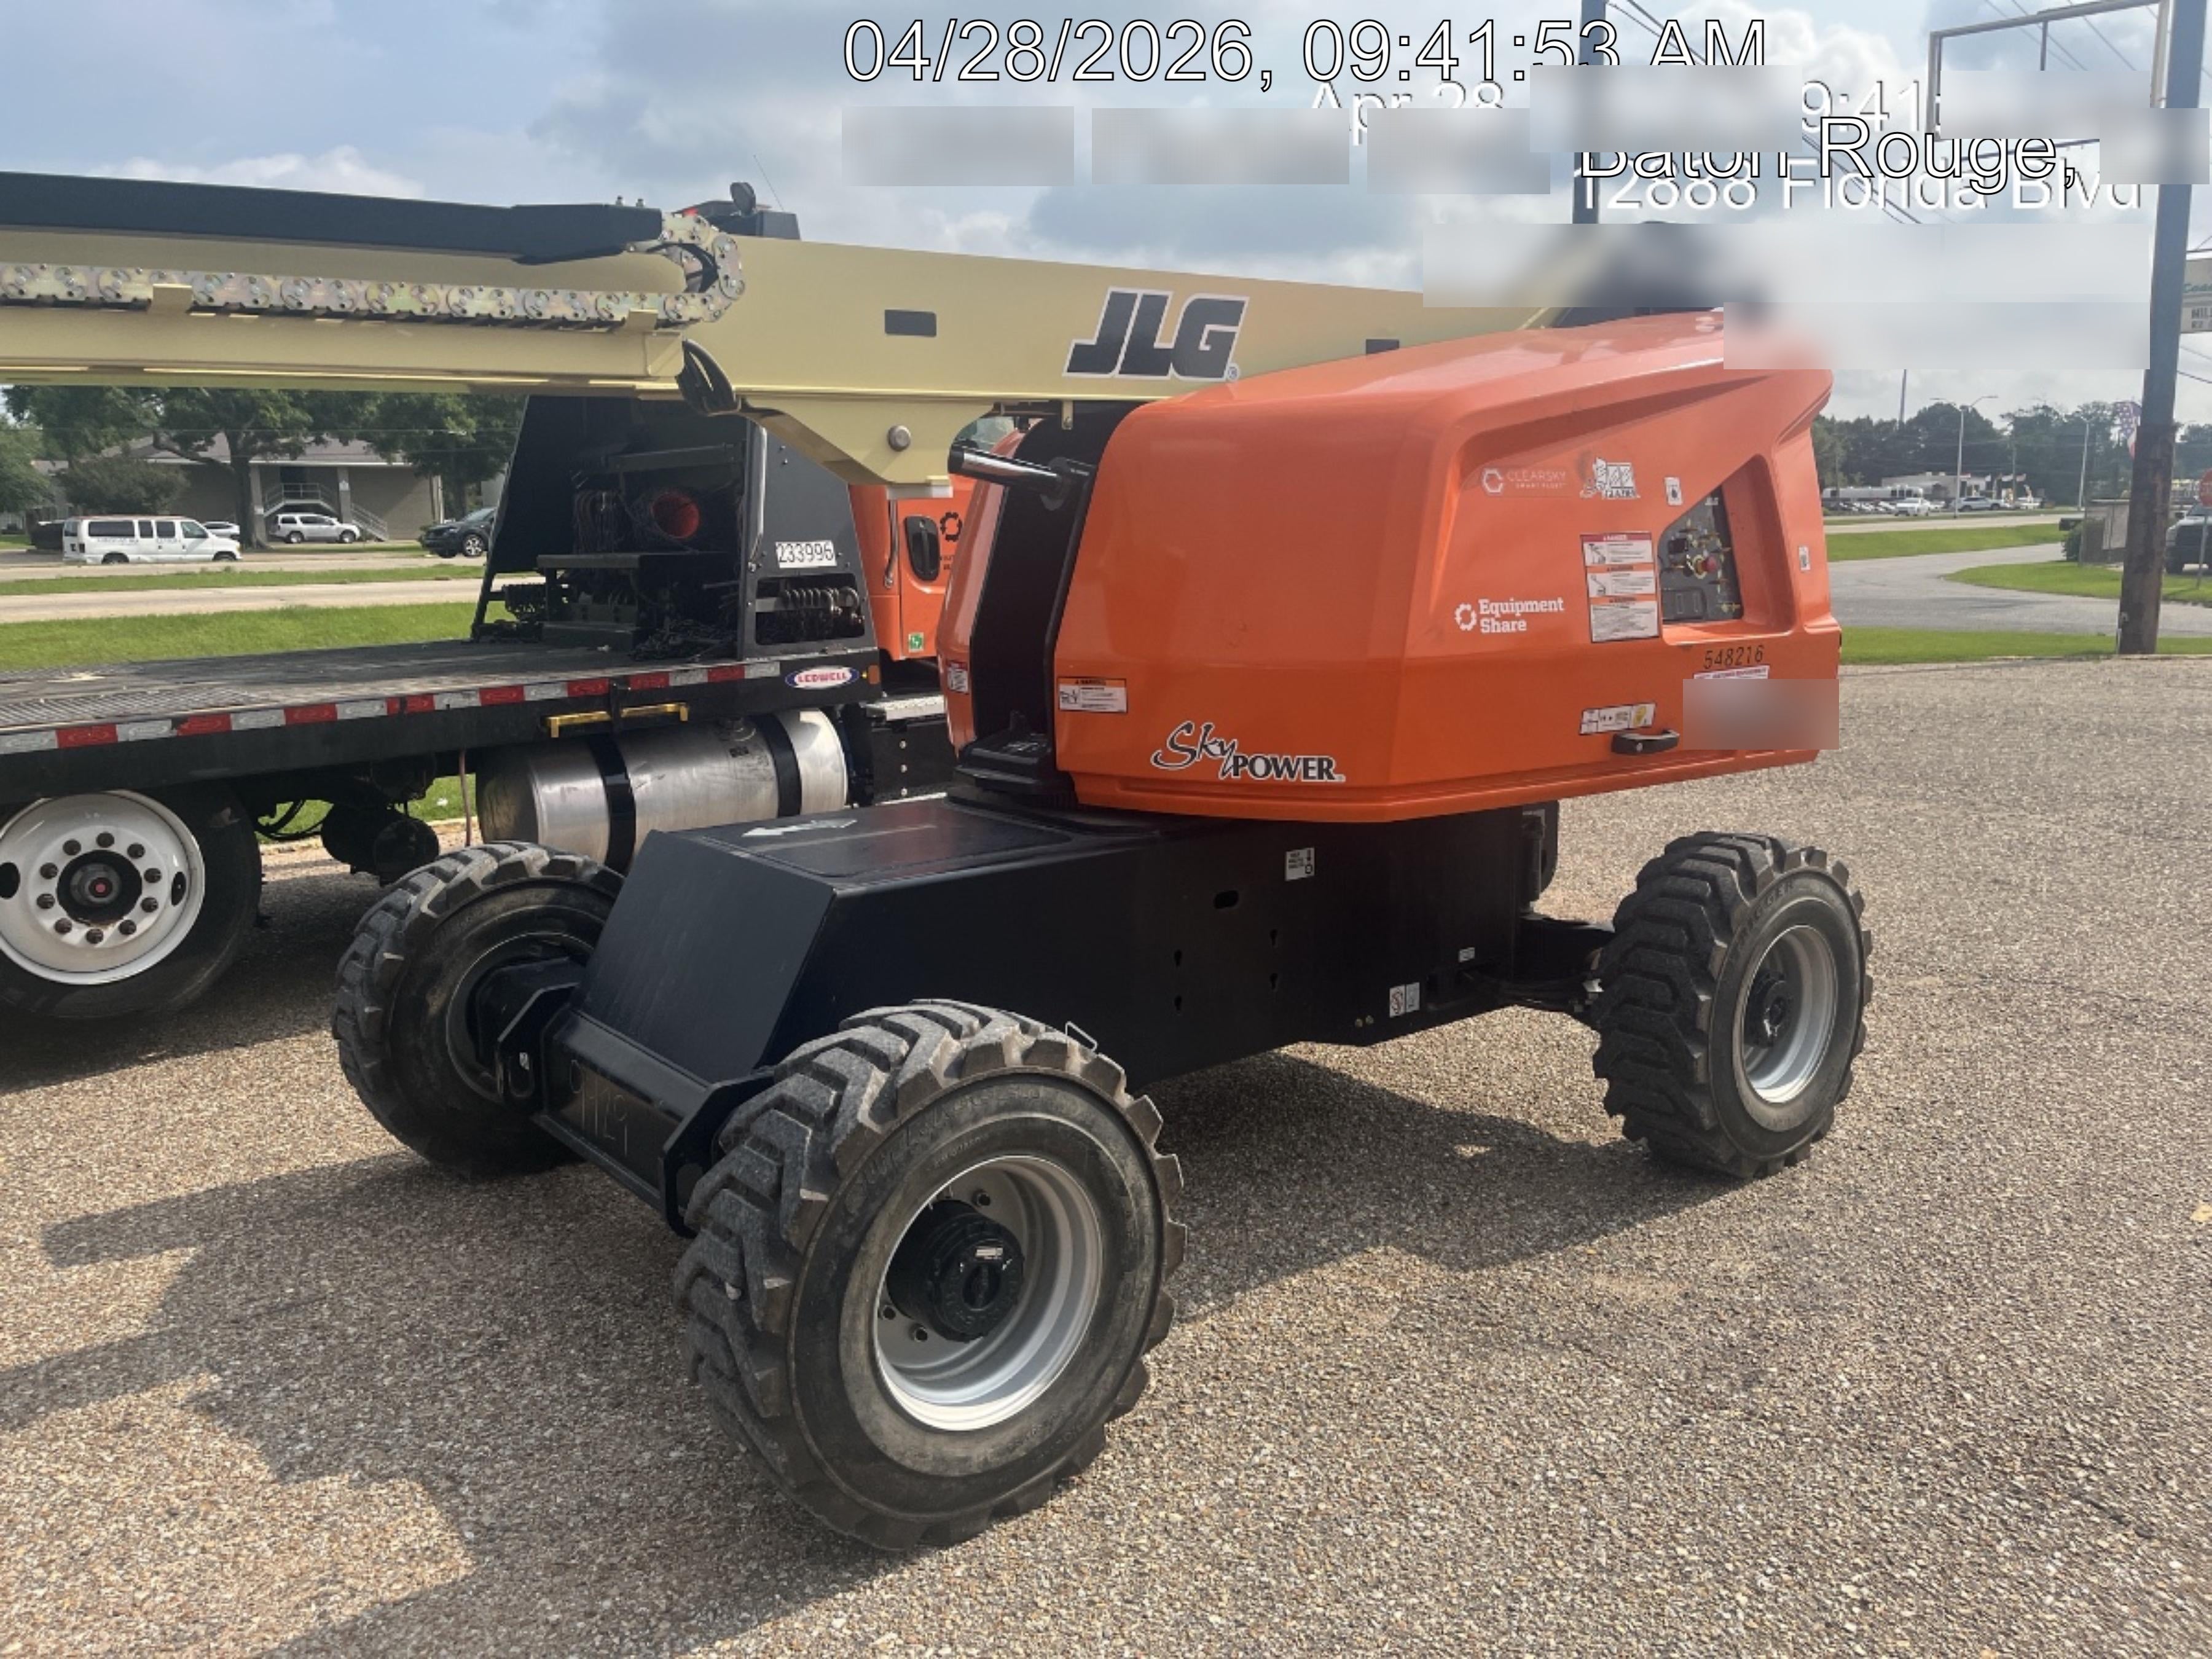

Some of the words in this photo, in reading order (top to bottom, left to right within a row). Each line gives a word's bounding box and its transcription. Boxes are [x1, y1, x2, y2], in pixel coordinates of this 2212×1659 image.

[1062, 286, 1250, 381] JLG
[777, 543, 834, 563] 233996
[1478, 597, 1564, 618] Equipment
[1480, 617, 1528, 633] Share
[1703, 645, 1765, 669] 548216
[798, 672, 846, 683] LEDWELL
[1150, 721, 1238, 780] Sky
[1231, 755, 1337, 782] POWER
